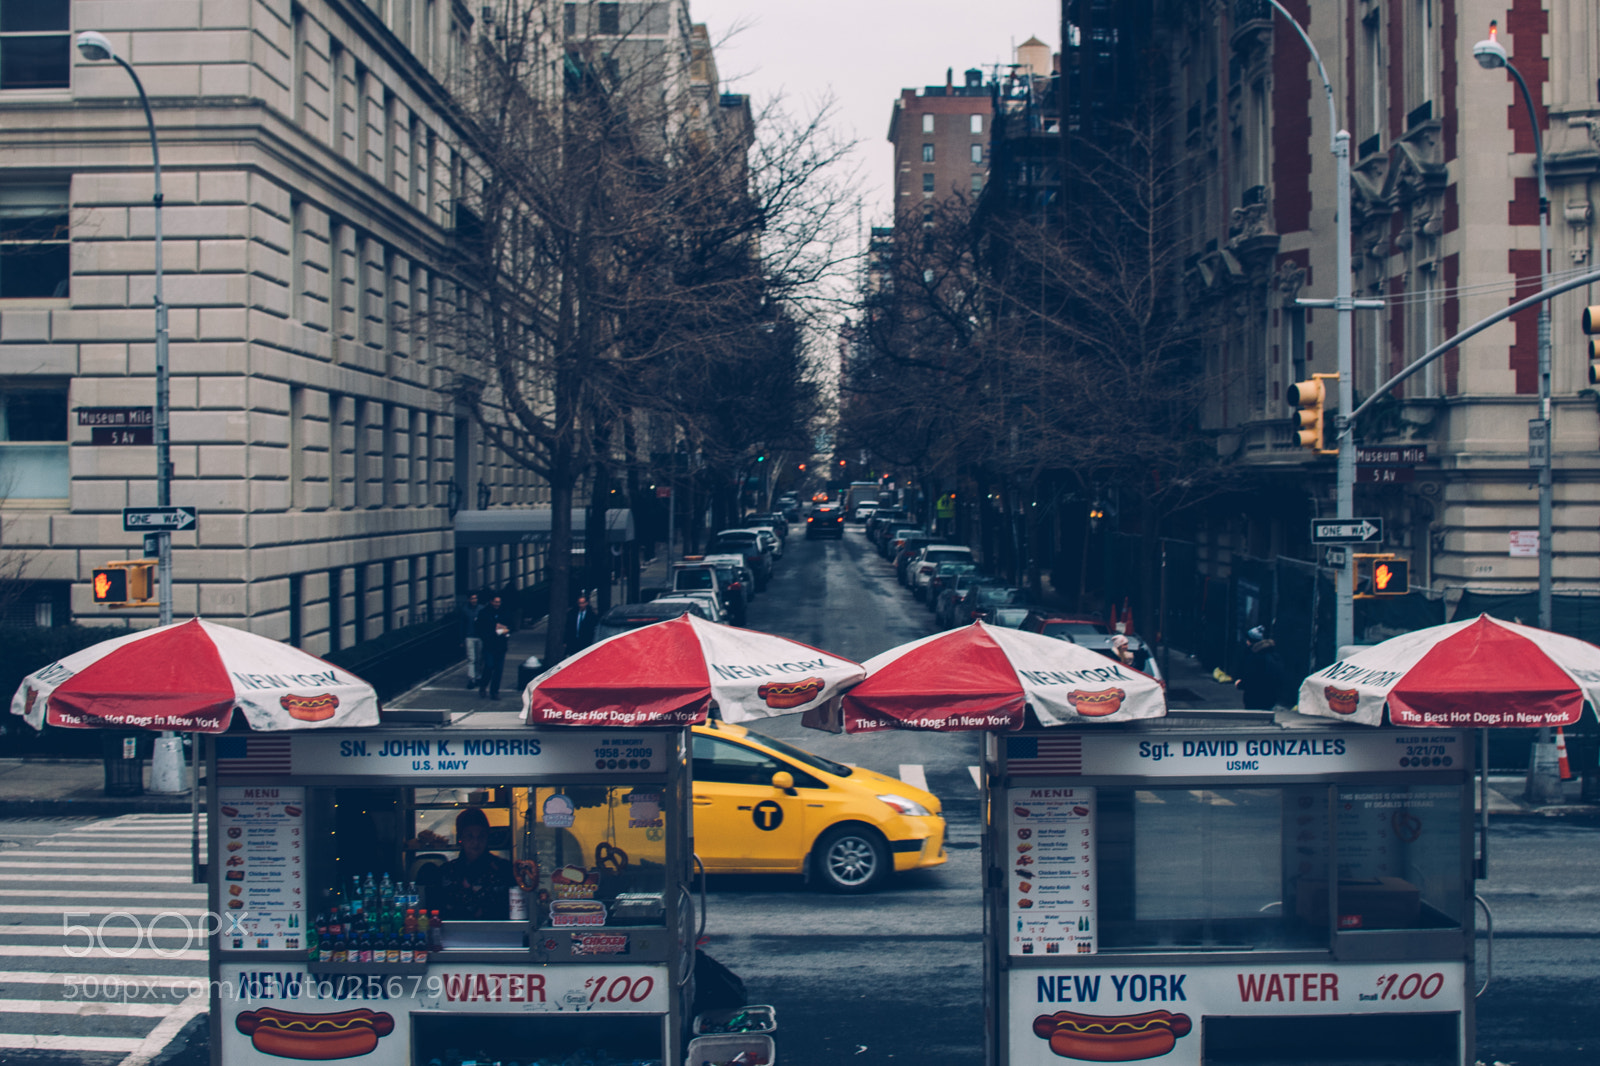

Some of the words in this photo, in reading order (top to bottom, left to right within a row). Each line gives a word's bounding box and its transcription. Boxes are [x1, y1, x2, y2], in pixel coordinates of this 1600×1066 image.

[80, 411, 125, 424] Museum
[129, 411, 152, 424] Mile
[112, 432, 118, 444] 5
[122, 432, 135, 444] Av
[1357, 450, 1399, 462] Museum
[1403, 450, 1425, 462] Mile
[1373, 470, 1379, 482] 5
[1383, 470, 1396, 482] Av
[129, 514, 151, 524] ONE
[162, 514, 186, 524] WAY
[1322, 527, 1342, 536] ONE
[1351, 526, 1373, 535] WAY
[711, 663, 772, 680] NEW
[766, 658, 838, 673] YORK
[1019, 669, 1076, 685] NEW
[1066, 665, 1134, 682] YORK
[1320, 661, 1370, 681] NEW
[1355, 670, 1405, 687] YORK
[232, 672, 290, 689] NEW
[282, 670, 350, 687] YORK
[60, 714, 81, 724] The
[105, 714, 124, 724] Hot
[126, 714, 152, 727] Dogs
[155, 714, 164, 724] in
[167, 715, 192, 726] New
[195, 716, 220, 728] York
[542, 708, 562, 719] The
[565, 709, 587, 720] Best
[589, 710, 607, 720] Hot
[610, 710, 635, 723] Dogs
[637, 711, 646, 720] in
[648, 711, 672, 721] New
[674, 711, 698, 721] York
[856, 718, 876, 728] The
[920, 718, 945, 729] Dogs
[948, 717, 958, 726] in
[961, 716, 984, 726] New
[987, 715, 1011, 725] York
[1400, 710, 1421, 722] The
[1424, 712, 1448, 722] Best
[1450, 712, 1470, 722] Hot
[1473, 712, 1500, 724] Dogs
[1503, 711, 1513, 722] in
[1516, 712, 1542, 722] New
[1544, 711, 1570, 722] York
[340, 740, 371, 757] SN.
[378, 740, 430, 757] JOHN
[438, 740, 455, 756] K.
[463, 739, 541, 756] MORRIS
[1139, 741, 1174, 761] Sgt.
[1183, 741, 1238, 757] DAVID
[1246, 739, 1346, 756] GONZALES
[1406, 745, 1445, 756] 3/21/70
[412, 760, 434, 770] U.S.
[438, 760, 469, 770] NAVY
[1227, 760, 1259, 770] USMC
[244, 789, 280, 798] MENU
[1030, 789, 1073, 798] MENU
[759, 806, 777, 827] T
[554, 884, 598, 892] POTATO
[554, 915, 575, 925] HOT
[577, 915, 603, 925] DOGS
[582, 936, 627, 945] CHICKEN
[239, 972, 303, 999] NEW
[312, 973, 389, 1000] YORK
[442, 973, 546, 1002] WATER
[584, 976, 654, 1003] $1.00
[1036, 975, 1101, 1002] NEW
[1110, 974, 1187, 1002] YORK
[1237, 973, 1339, 1002] WATER
[1359, 993, 1378, 1001] Small
[1376, 972, 1445, 1000] $1.00
